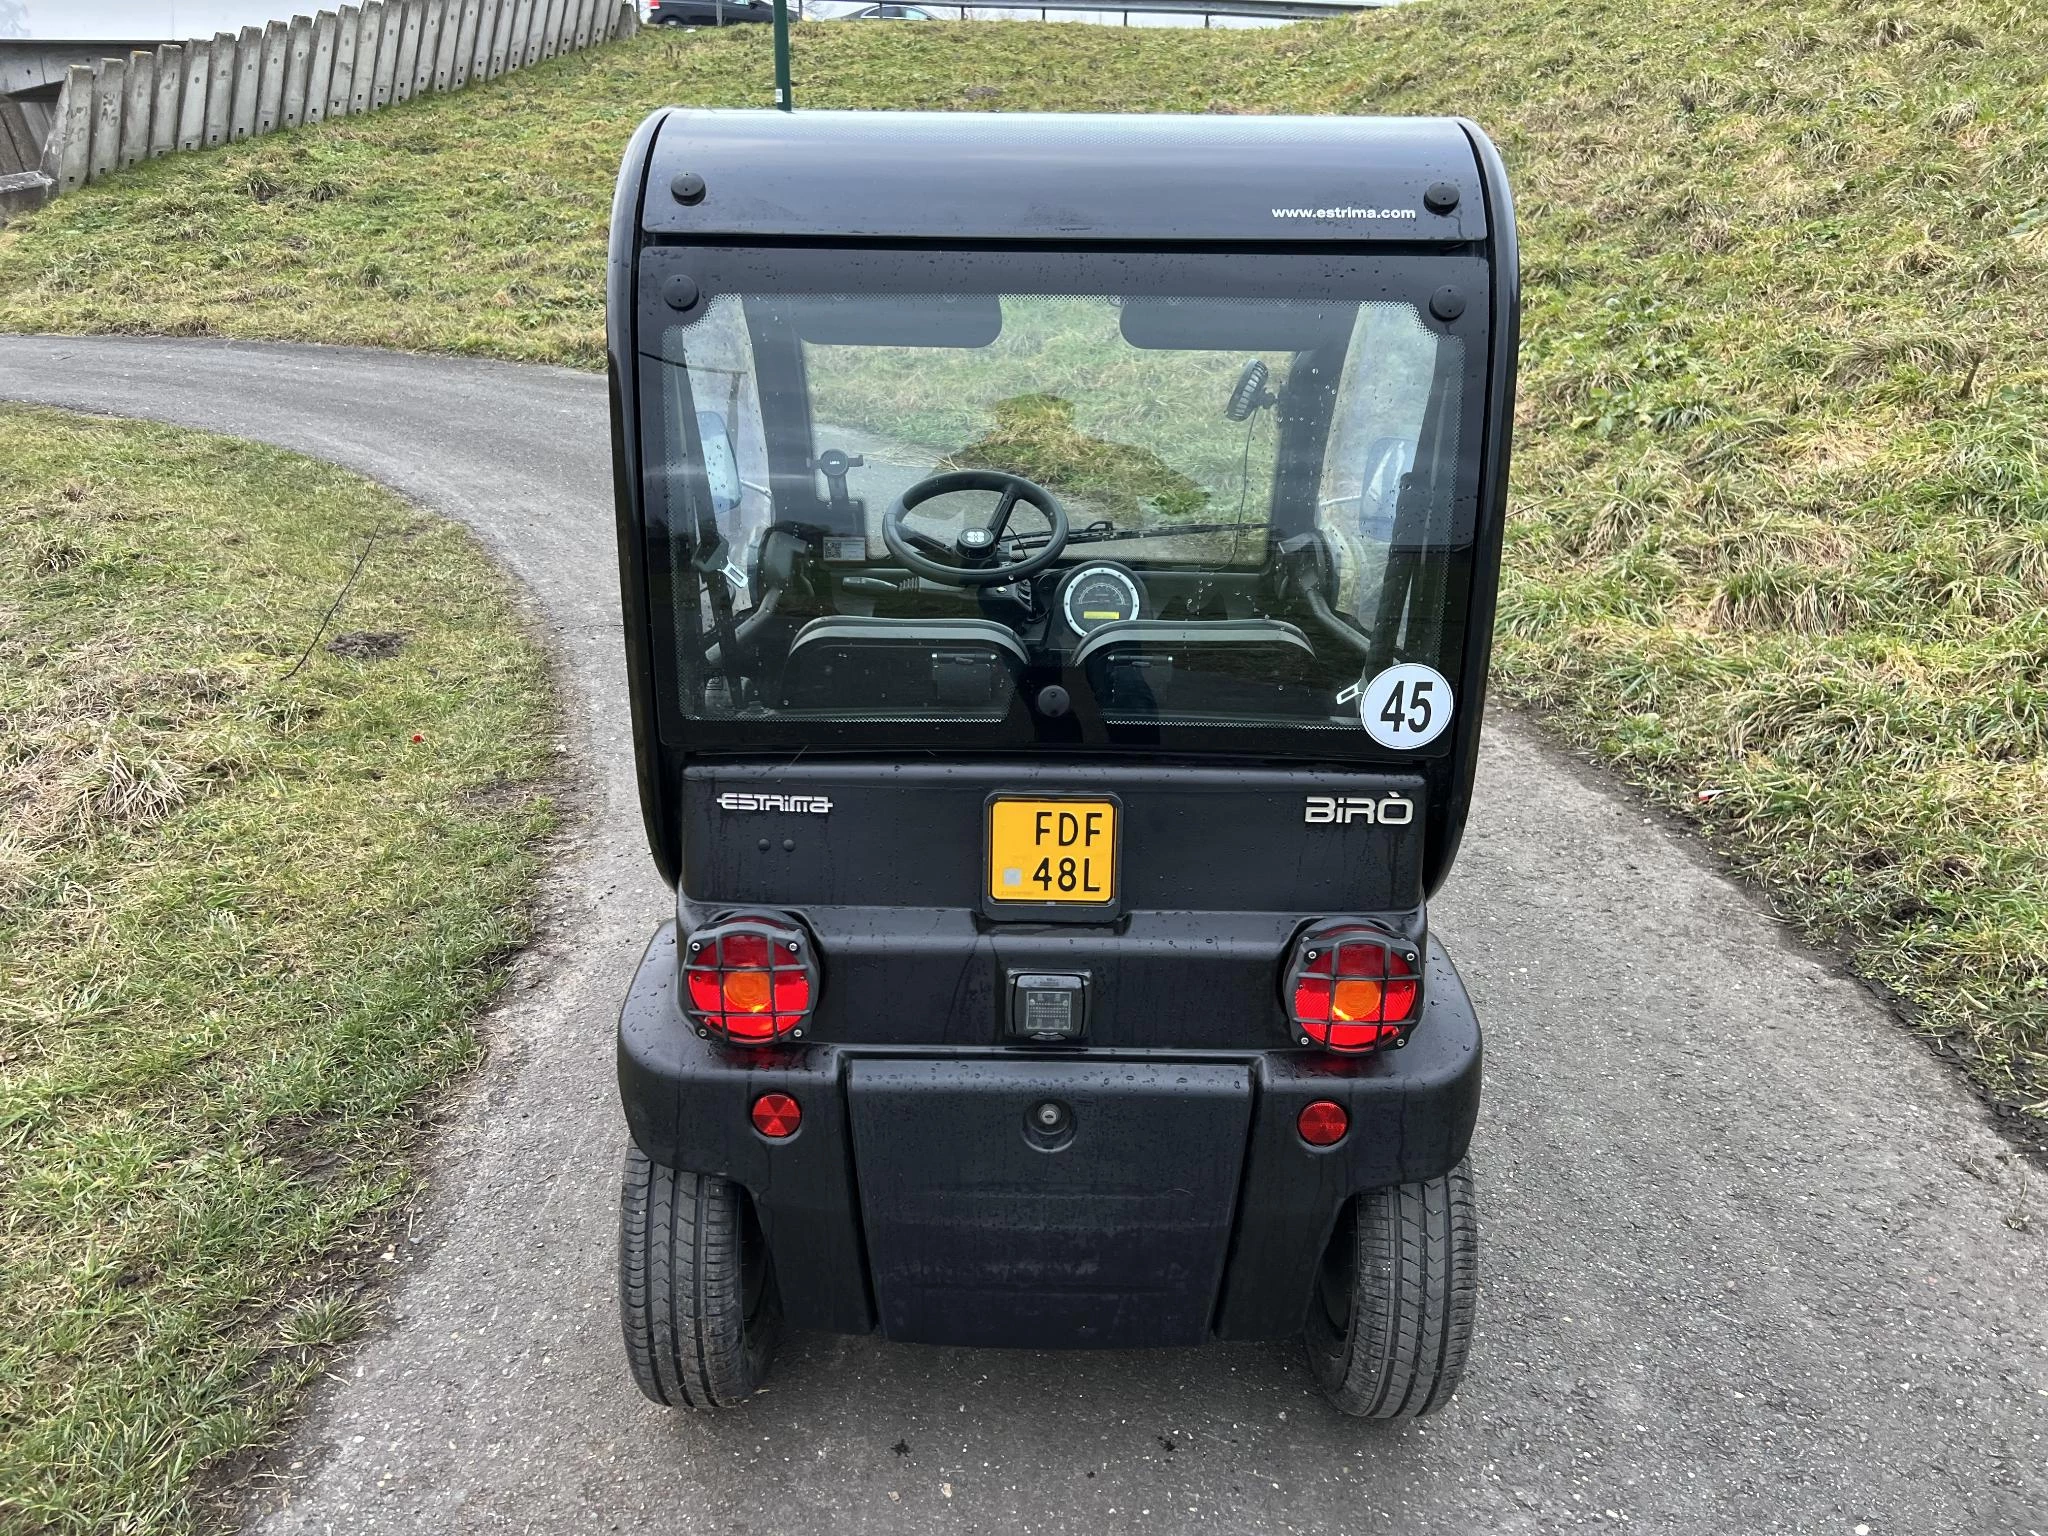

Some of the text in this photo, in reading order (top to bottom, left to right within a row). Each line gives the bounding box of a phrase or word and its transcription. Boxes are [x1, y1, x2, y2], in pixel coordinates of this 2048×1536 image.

[1271, 206, 1416, 219] www.estrima.com
[1380, 680, 1434, 734] 45
[1035, 811, 1103, 847] FDF
[1032, 857, 1102, 892] 48L
